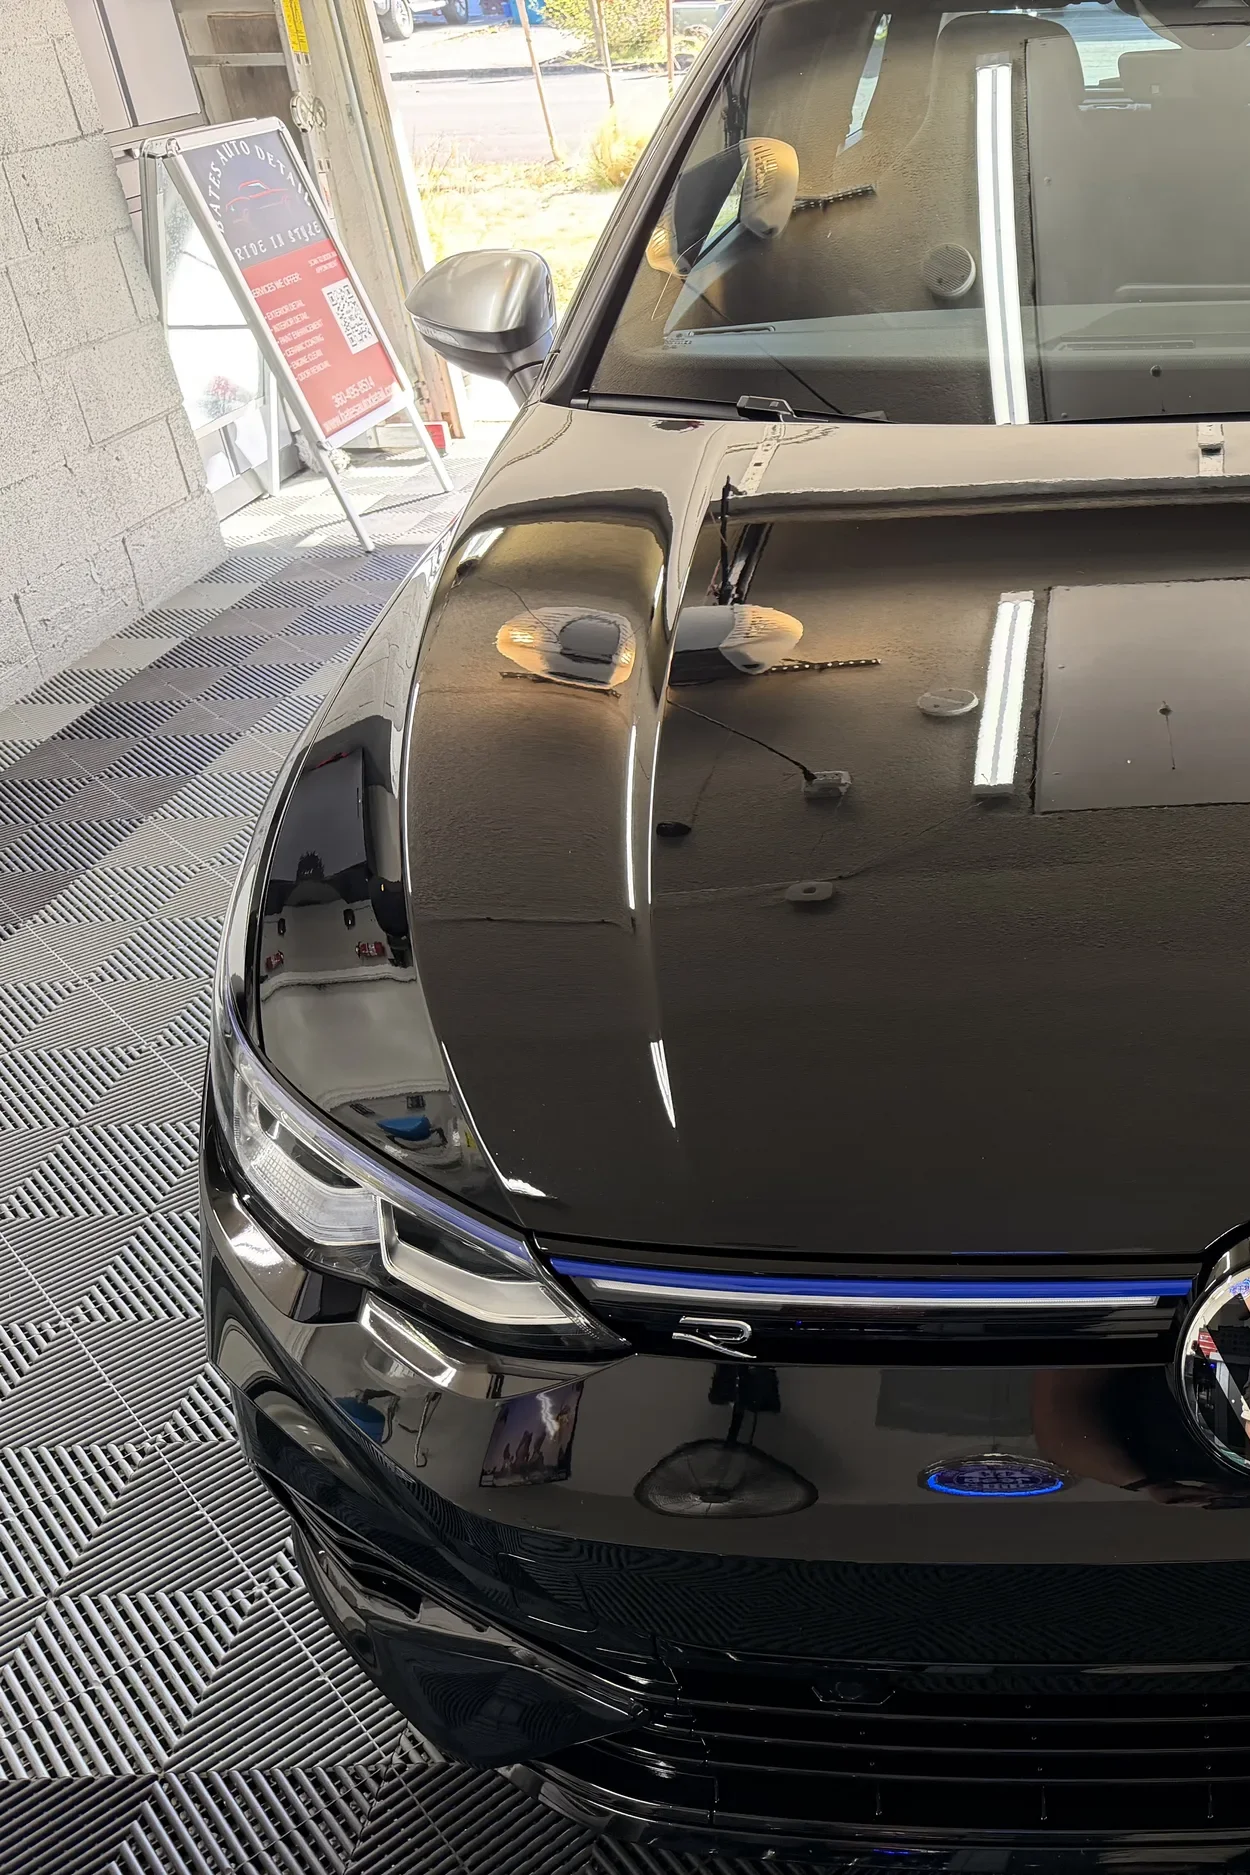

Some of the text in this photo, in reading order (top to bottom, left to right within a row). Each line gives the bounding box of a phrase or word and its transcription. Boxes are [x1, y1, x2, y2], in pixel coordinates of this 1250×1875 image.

[208, 139, 311, 234] BATES AUTO DETAIL
[234, 220, 321, 261] RIDE IN STYLE
[253, 284, 276, 297] ERVICES
